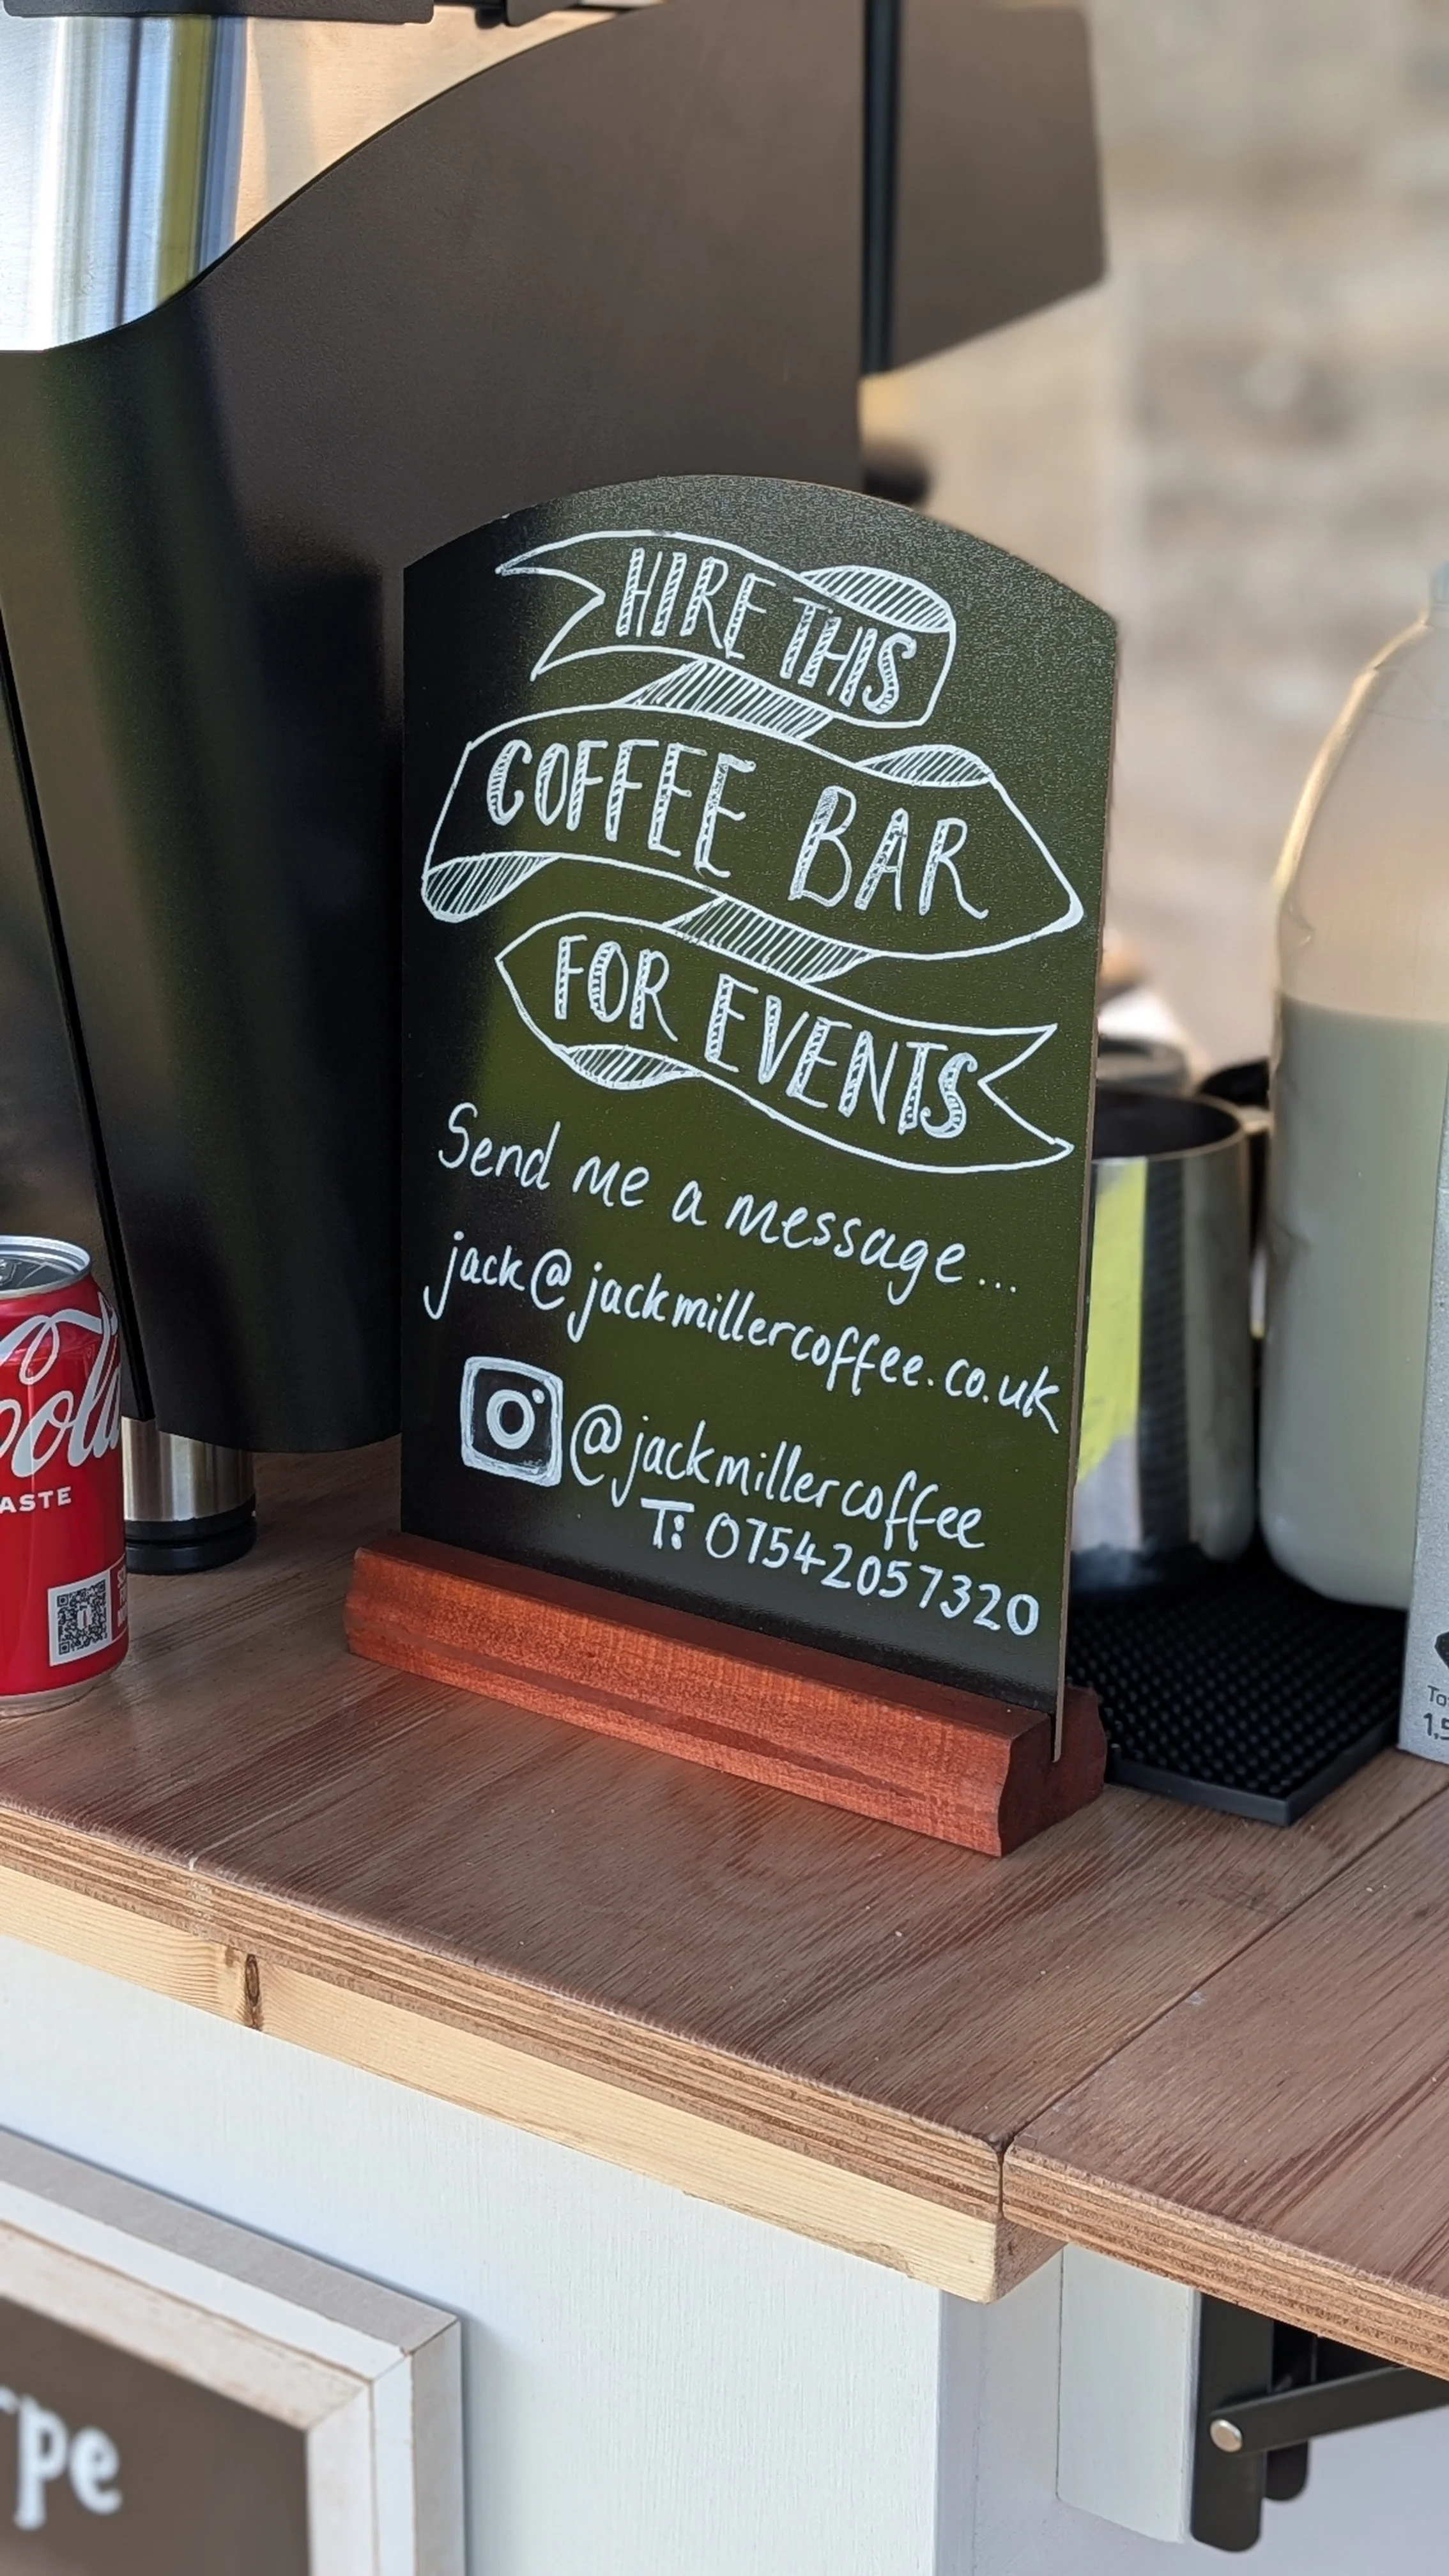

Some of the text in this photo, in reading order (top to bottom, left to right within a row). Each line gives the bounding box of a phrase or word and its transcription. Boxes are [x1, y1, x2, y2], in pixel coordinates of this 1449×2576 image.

[616, 548, 916, 715] HIRE THIS
[486, 739, 989, 919] COFFEE BAR
[554, 934, 978, 1138] FOR EVENTS
[438, 1102, 561, 1191] Send
[572, 1155, 650, 1208] me
[671, 1181, 707, 1226] a
[569, 1402, 987, 1551] @jackmillercoffee
[705, 1511, 1039, 1637] 07542057320
[1427, 1685, 1449, 1707] To
[0, 2386, 123, 2531] pe
